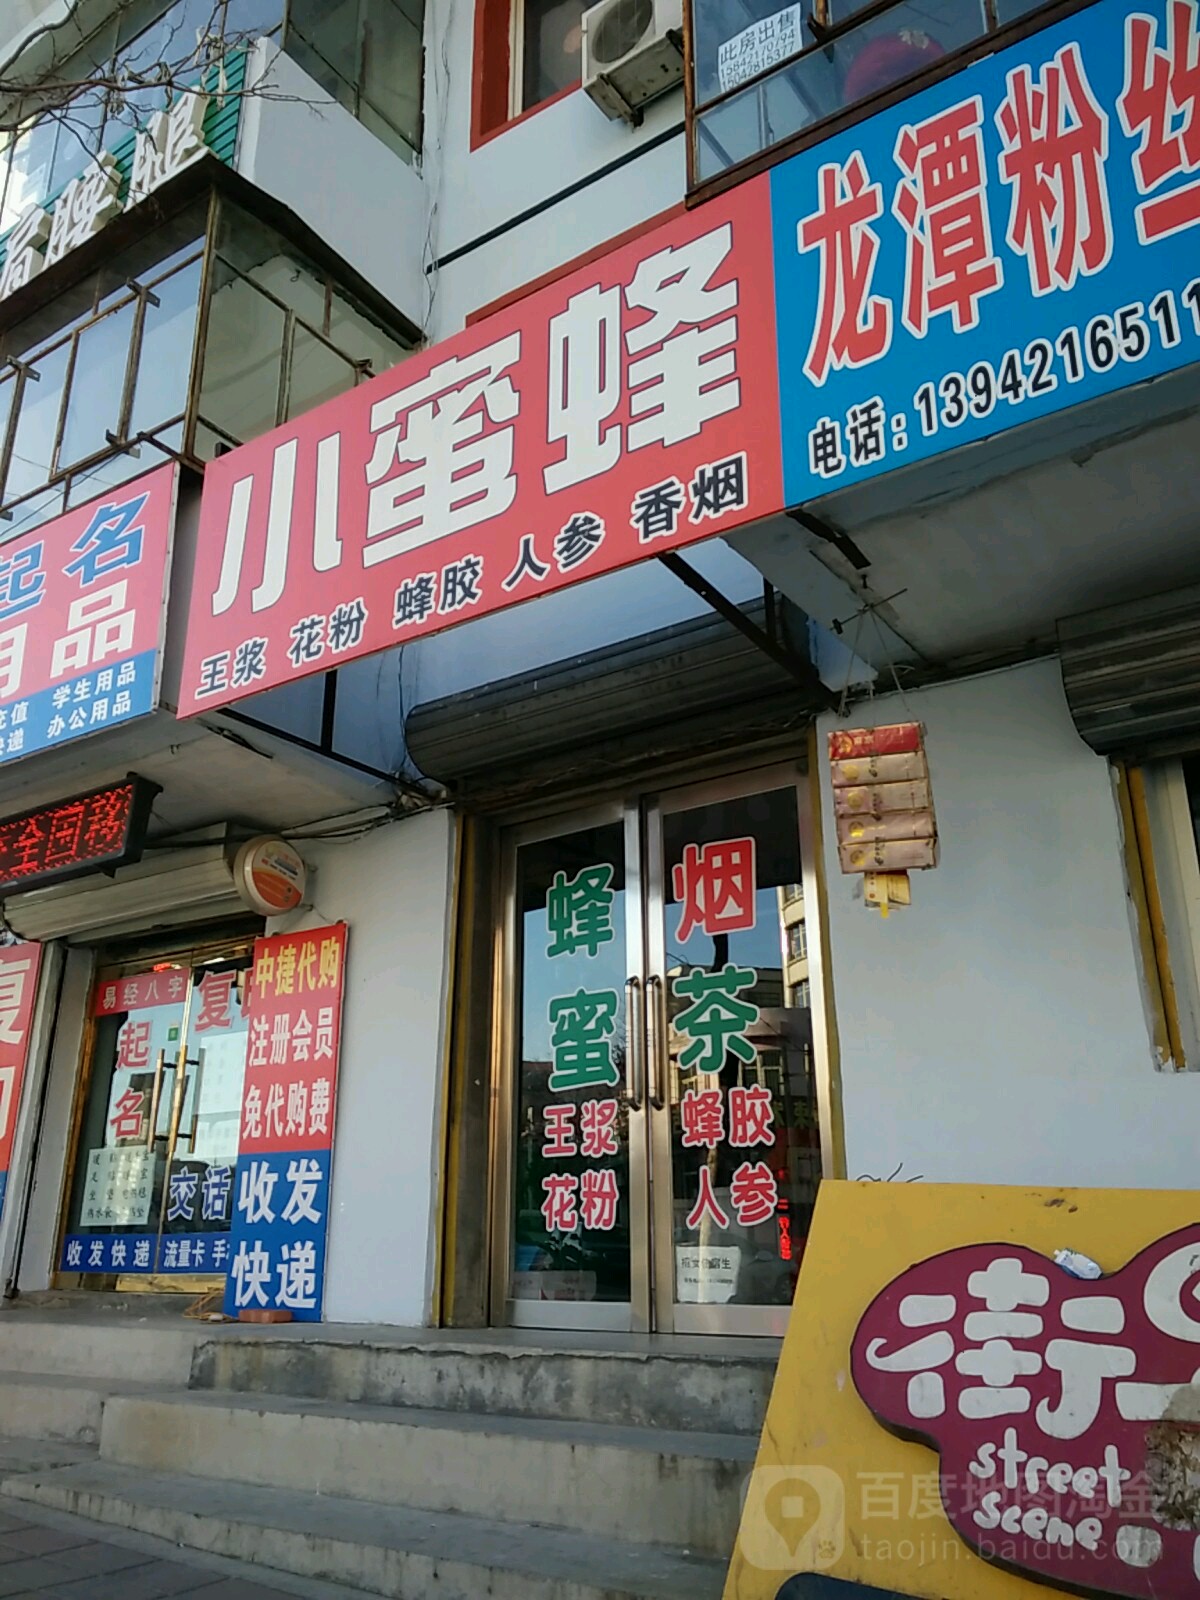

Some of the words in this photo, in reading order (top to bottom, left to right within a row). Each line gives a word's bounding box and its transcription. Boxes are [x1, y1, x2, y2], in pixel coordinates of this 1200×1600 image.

[720, 10, 795, 66] 此房出售
[797, 0, 1200, 387] 龙潭粉丝
[212, 220, 741, 616] 小蜜蜂
[195, 637, 268, 700] 王浆
[288, 597, 368, 668] 花粉
[392, 554, 484, 629] 蜂胶
[502, 511, 605, 592] 人参
[630, 450, 749, 543] 香烟
[52, 660, 136, 710] 学生用品
[0, 727, 25, 756] 递
[46, 690, 132, 739] 办公用品
[671, 836, 758, 945] 烟
[102, 976, 184, 1011] 易经八字
[255, 936, 341, 998] 中捷代购
[546, 863, 620, 1093] 蜂蜜
[248, 1006, 335, 1067] 注册会员
[672, 963, 760, 1075] 茶
[110, 1021, 153, 1141] 起名
[242, 1078, 332, 1140] 免代购费
[541, 1099, 620, 1158] 王浆
[681, 1083, 776, 1149] 蜂胶
[237, 1158, 324, 1226] 收发
[541, 1168, 620, 1233] 花粉
[685, 1161, 778, 1231] 人参
[66, 1238, 152, 1268] 收发快递
[163, 1240, 206, 1269] 流量卡
[211, 1239, 231, 1267] 手
[230, 1241, 319, 1309] 快递
[969, 1428, 1132, 1509] street
[972, 1491, 1103, 1551] scene
